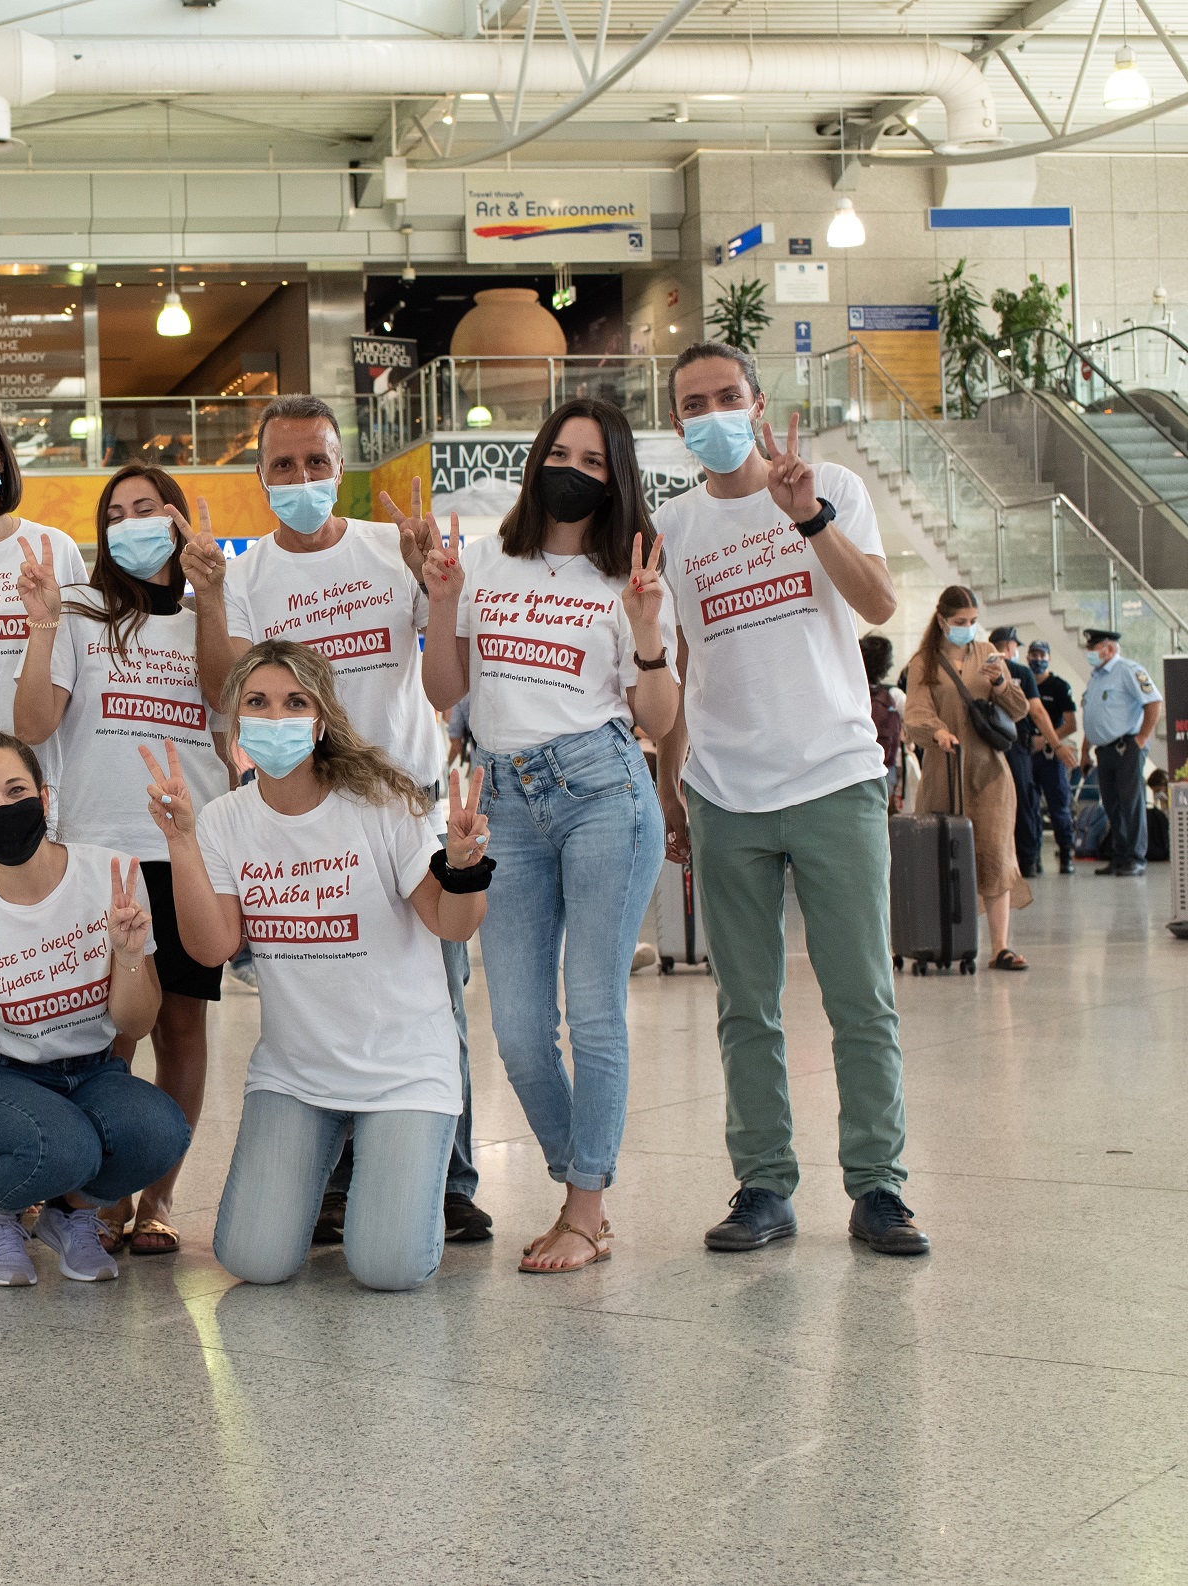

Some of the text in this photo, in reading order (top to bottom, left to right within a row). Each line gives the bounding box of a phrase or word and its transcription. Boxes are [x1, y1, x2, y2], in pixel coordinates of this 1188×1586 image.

[476, 201, 635, 217] Art & Environment
[494, 190, 524, 199] through
[29, 373, 45, 384] OF
[432, 444, 451, 468] Η
[459, 444, 533, 468] ΜΟΥΣ
[432, 467, 525, 492] ΑΠΟΓΕ
[684, 521, 784, 575] Ζήστε το όνειρό
[694, 536, 807, 593] Είμαστε μαζί σας!
[288, 580, 372, 611] Μας κάνετε
[474, 588, 615, 615] Είστε έμπνευση!
[705, 576, 807, 620] ΚΩΤΣΟΒΟΛΟΣ
[265, 587, 394, 639] πάντα υπερήφανους!
[480, 608, 593, 629] Πάμε δυνατά!
[310, 632, 385, 657] ΣΟΒΟΛΟΣ
[480, 638, 578, 670] ΚΩΤΣΟΒΟΛΟΣ
[108, 670, 198, 687] Καλή επιτυχία!
[146, 661, 190, 675] καρδιάς
[107, 697, 201, 726] ΚΩΤΣΟΒΟΛΟΣ
[240, 850, 359, 881] Καλή επιτυχία
[243, 875, 350, 909] Ελλάδα μας!
[21, 948, 36, 960] το
[41, 923, 83, 953] όνειρό
[246, 919, 352, 939] ΚΩΤΣΟΒΟΛΟΣ
[49, 951, 80, 982] μαζί
[83, 938, 108, 961] σας!
[5, 981, 110, 1022] ΚΩΤΣΟΒΟΛΟΣ
